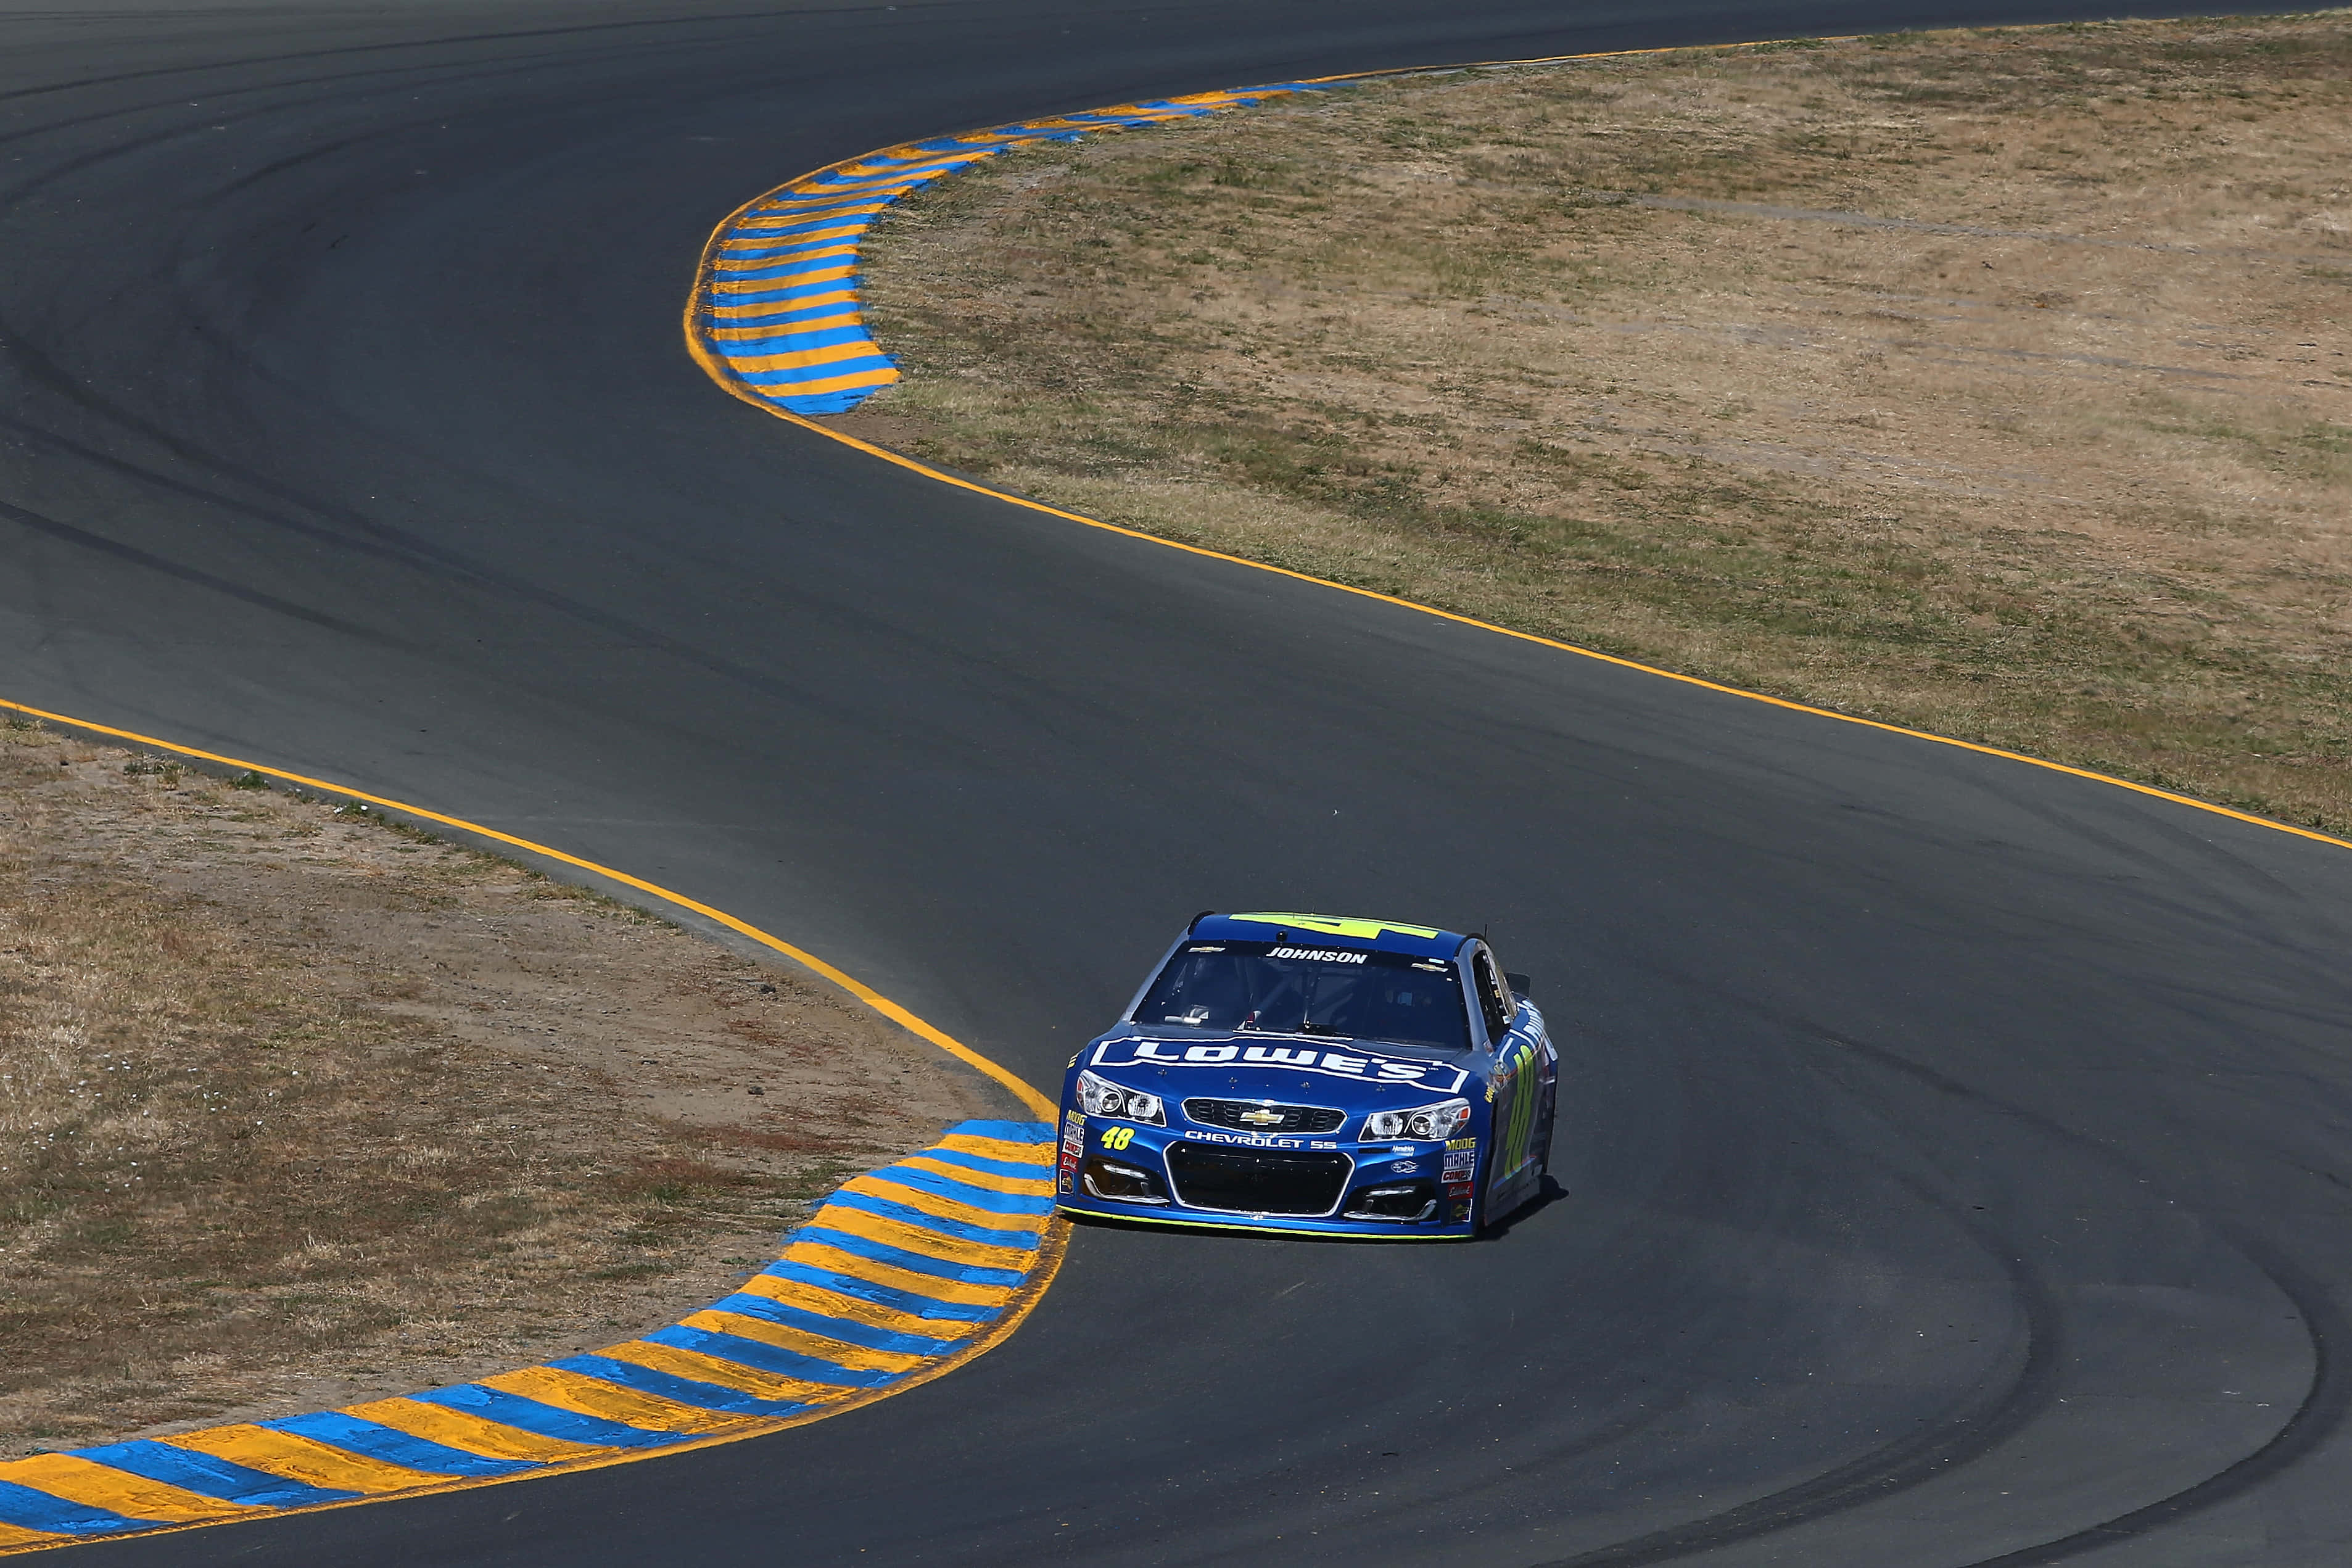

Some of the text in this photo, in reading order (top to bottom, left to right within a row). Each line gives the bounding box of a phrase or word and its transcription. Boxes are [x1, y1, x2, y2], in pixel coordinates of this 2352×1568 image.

[1266, 947, 1368, 964] JOHNSON
[1133, 1041, 1427, 1079] LOWE'S
[1067, 1110, 1087, 1126] MOOG
[1101, 1126, 1135, 1150] 48
[1184, 1131, 1337, 1149] CHEVROLET SS
[1445, 1137, 1476, 1151] MOOG
[1445, 1152, 1474, 1166] MAHLE
